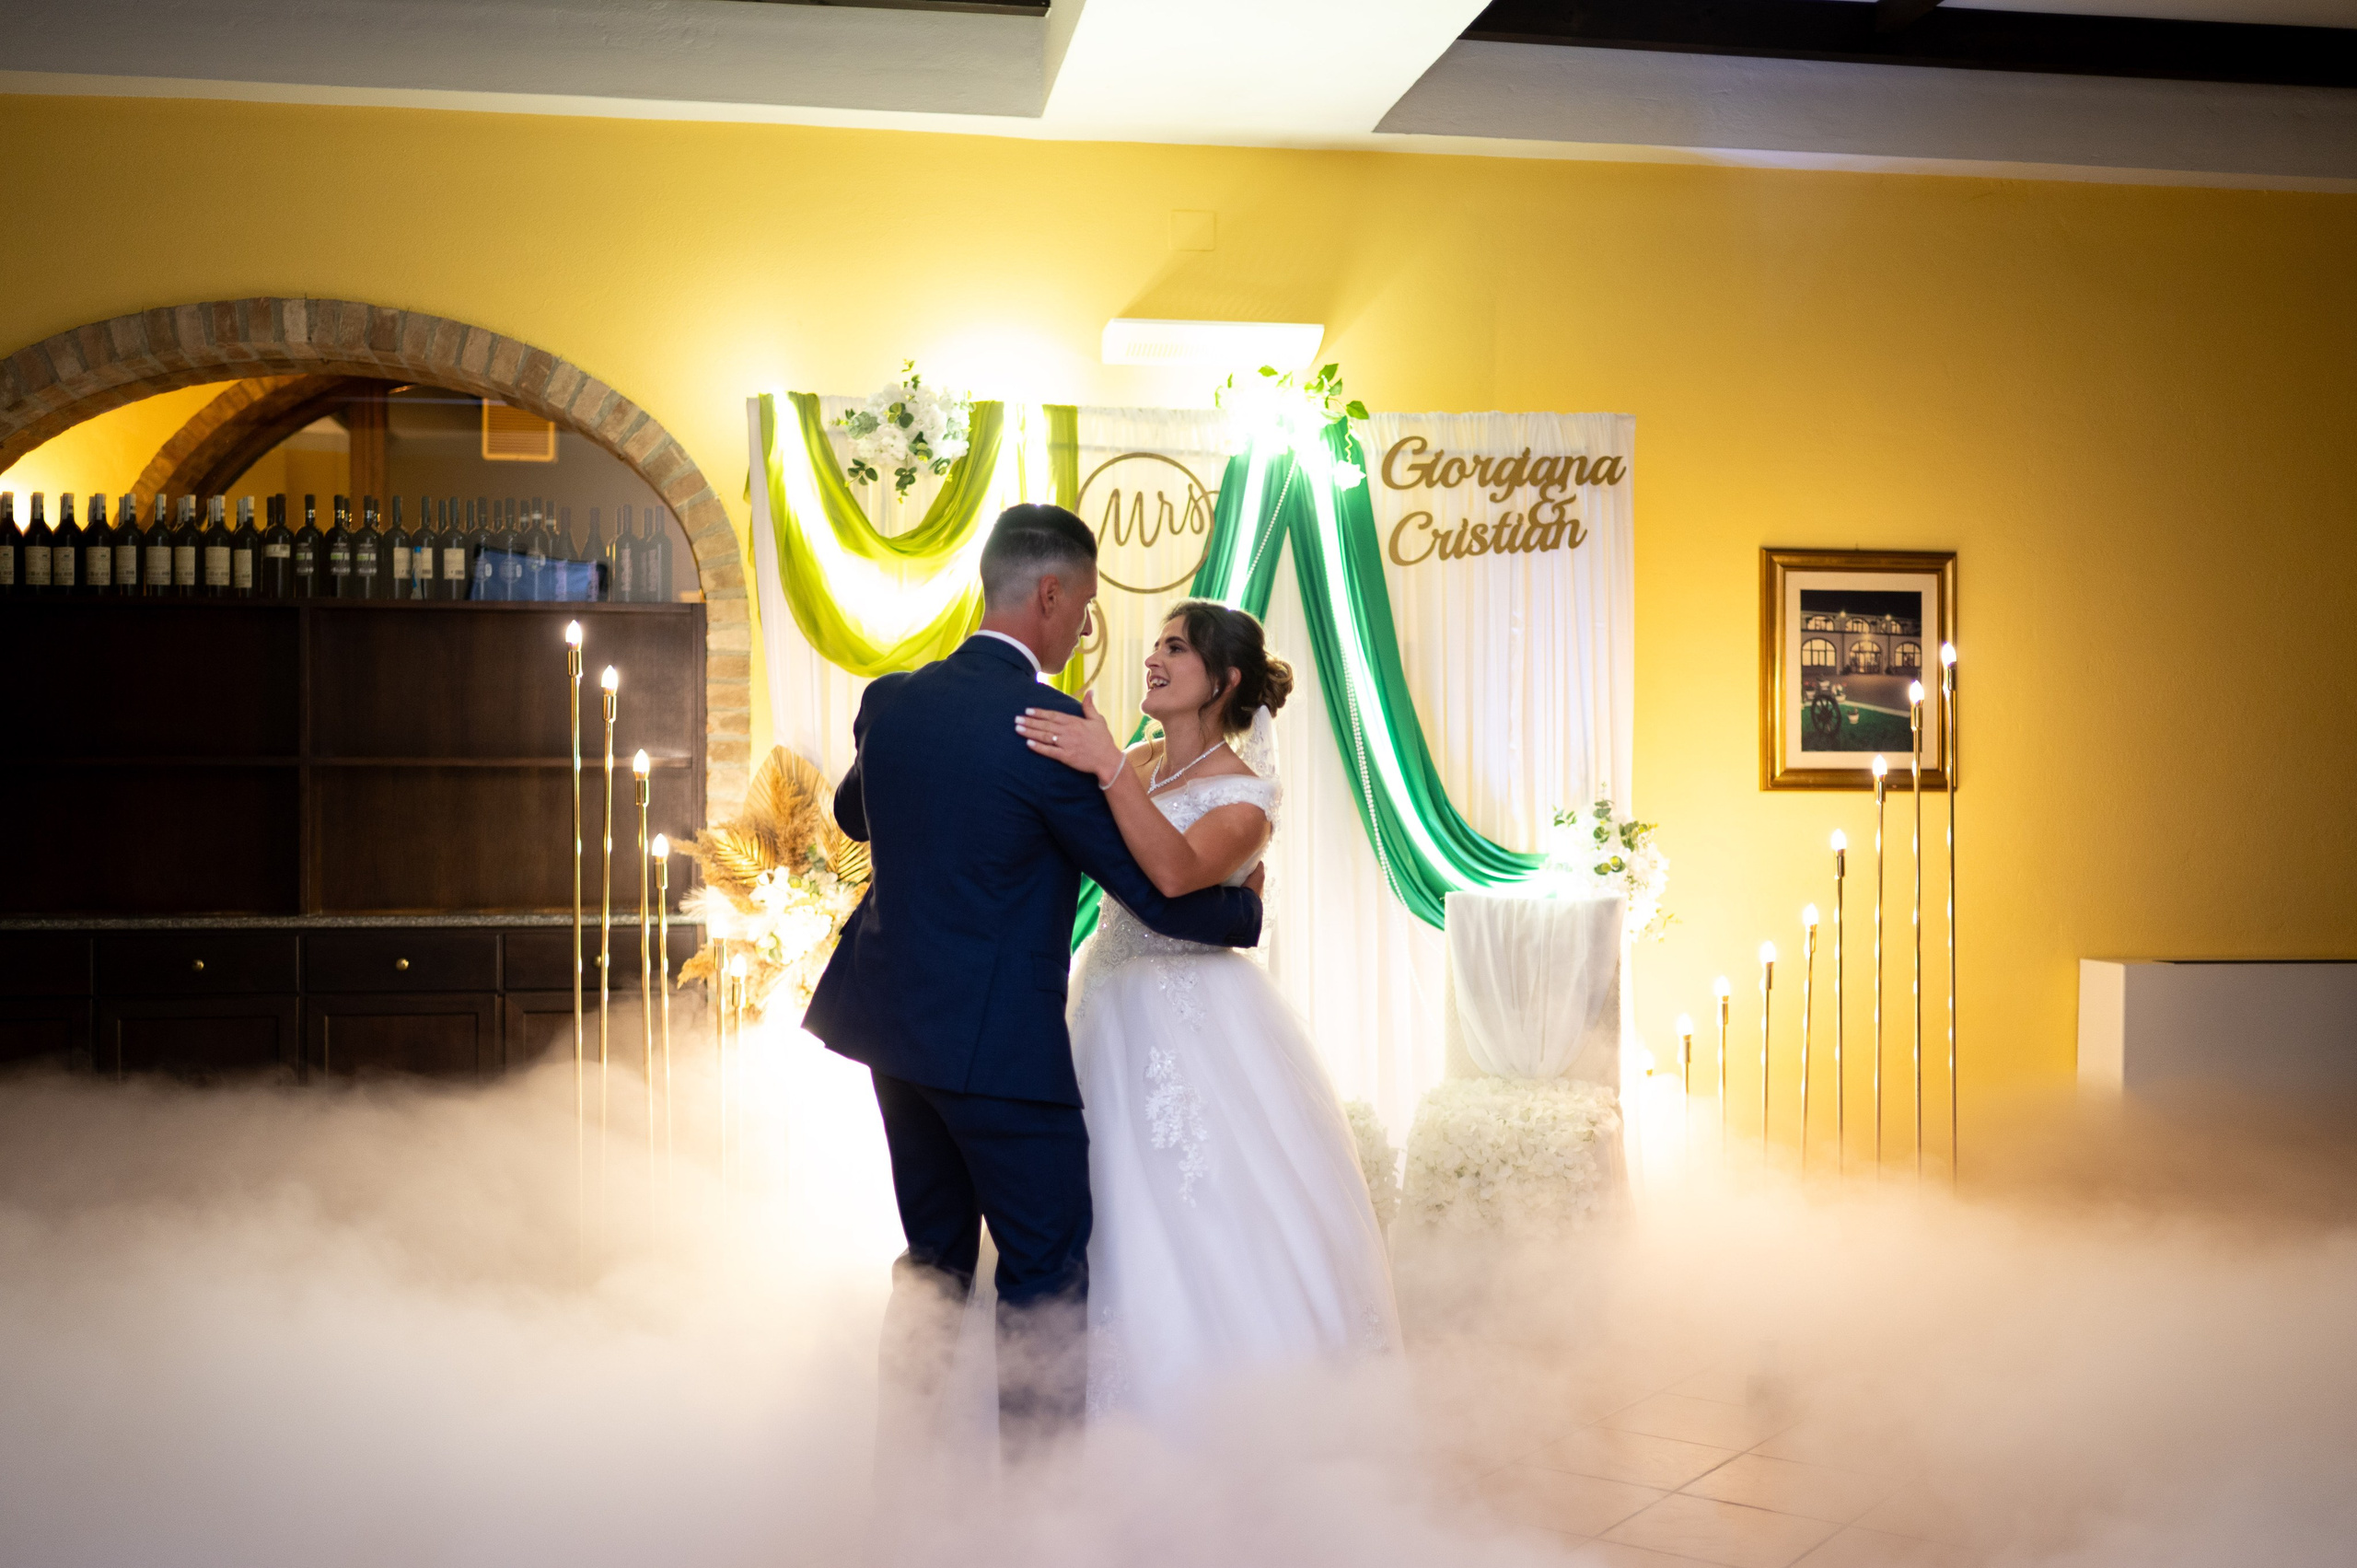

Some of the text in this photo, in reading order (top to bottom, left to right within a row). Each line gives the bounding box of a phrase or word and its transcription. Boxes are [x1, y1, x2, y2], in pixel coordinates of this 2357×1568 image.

[1381, 436, 1627, 504] Giorgiana
[1527, 482, 1577, 529] &
[1387, 510, 1588, 567] Cristian
